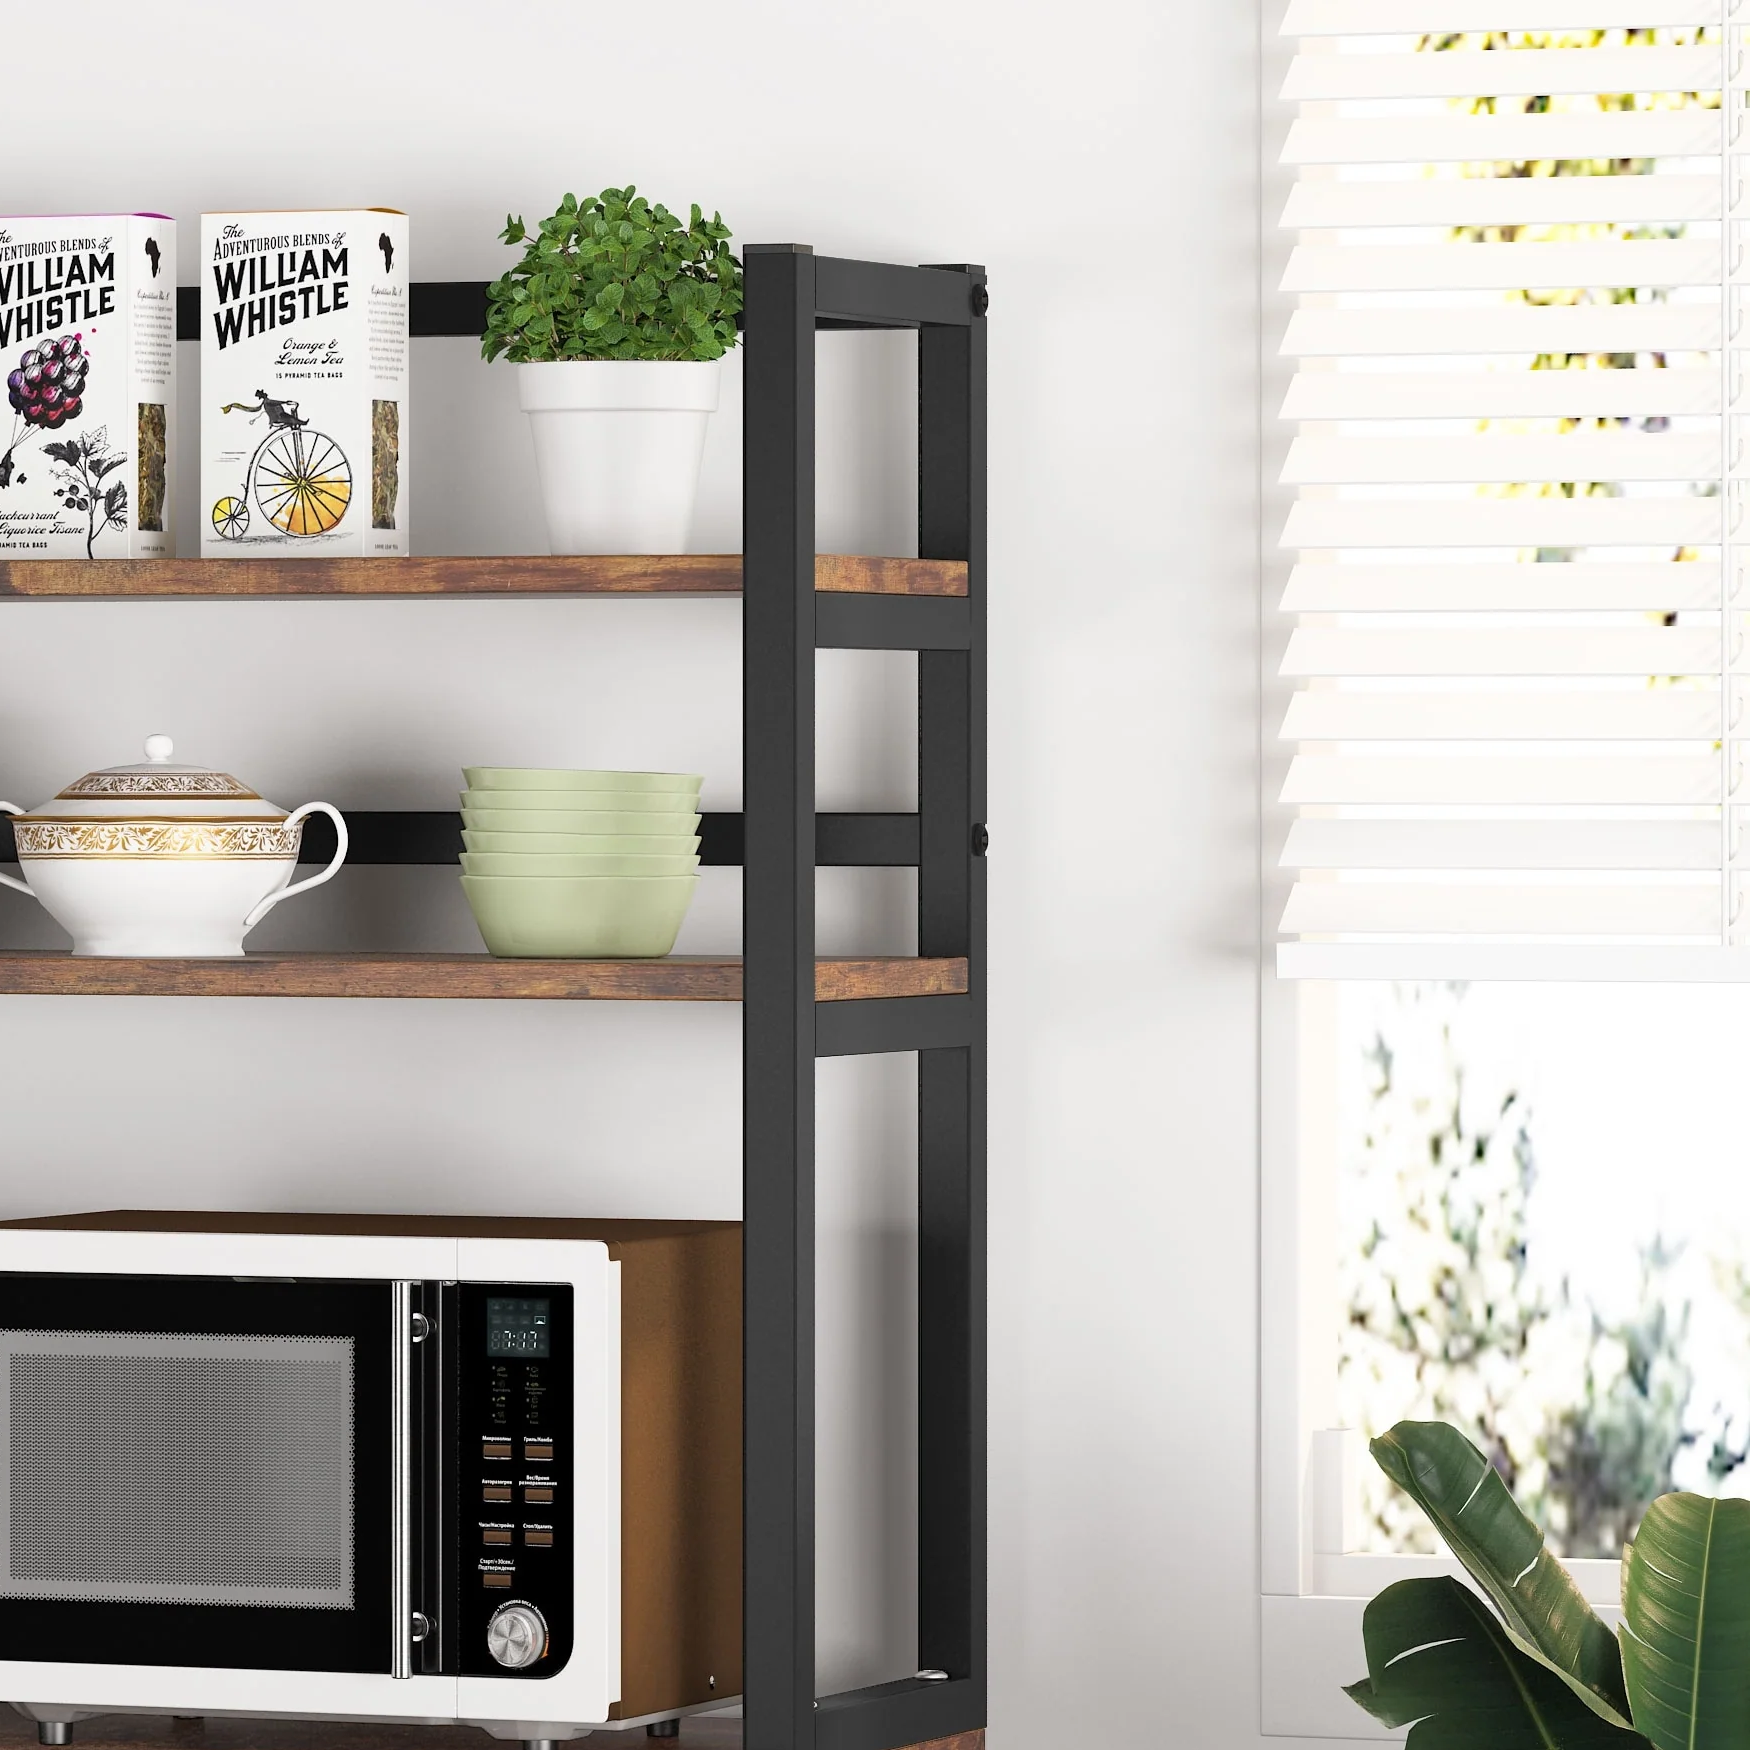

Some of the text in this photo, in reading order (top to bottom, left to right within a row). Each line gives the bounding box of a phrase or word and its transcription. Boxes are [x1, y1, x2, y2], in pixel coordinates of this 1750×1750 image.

[222, 223, 245, 240] The
[293, 233, 330, 247] BLENDS
[60, 238, 97, 252] BLENDS
[213, 247, 348, 306] WILLIAM
[213, 281, 349, 350] WHISTLE
[283, 337, 338, 354] Orange &
[274, 351, 344, 365] Lemon Tea
[48, 521, 86, 534] Tisane
[504, 1330, 537, 1348] 7:17
